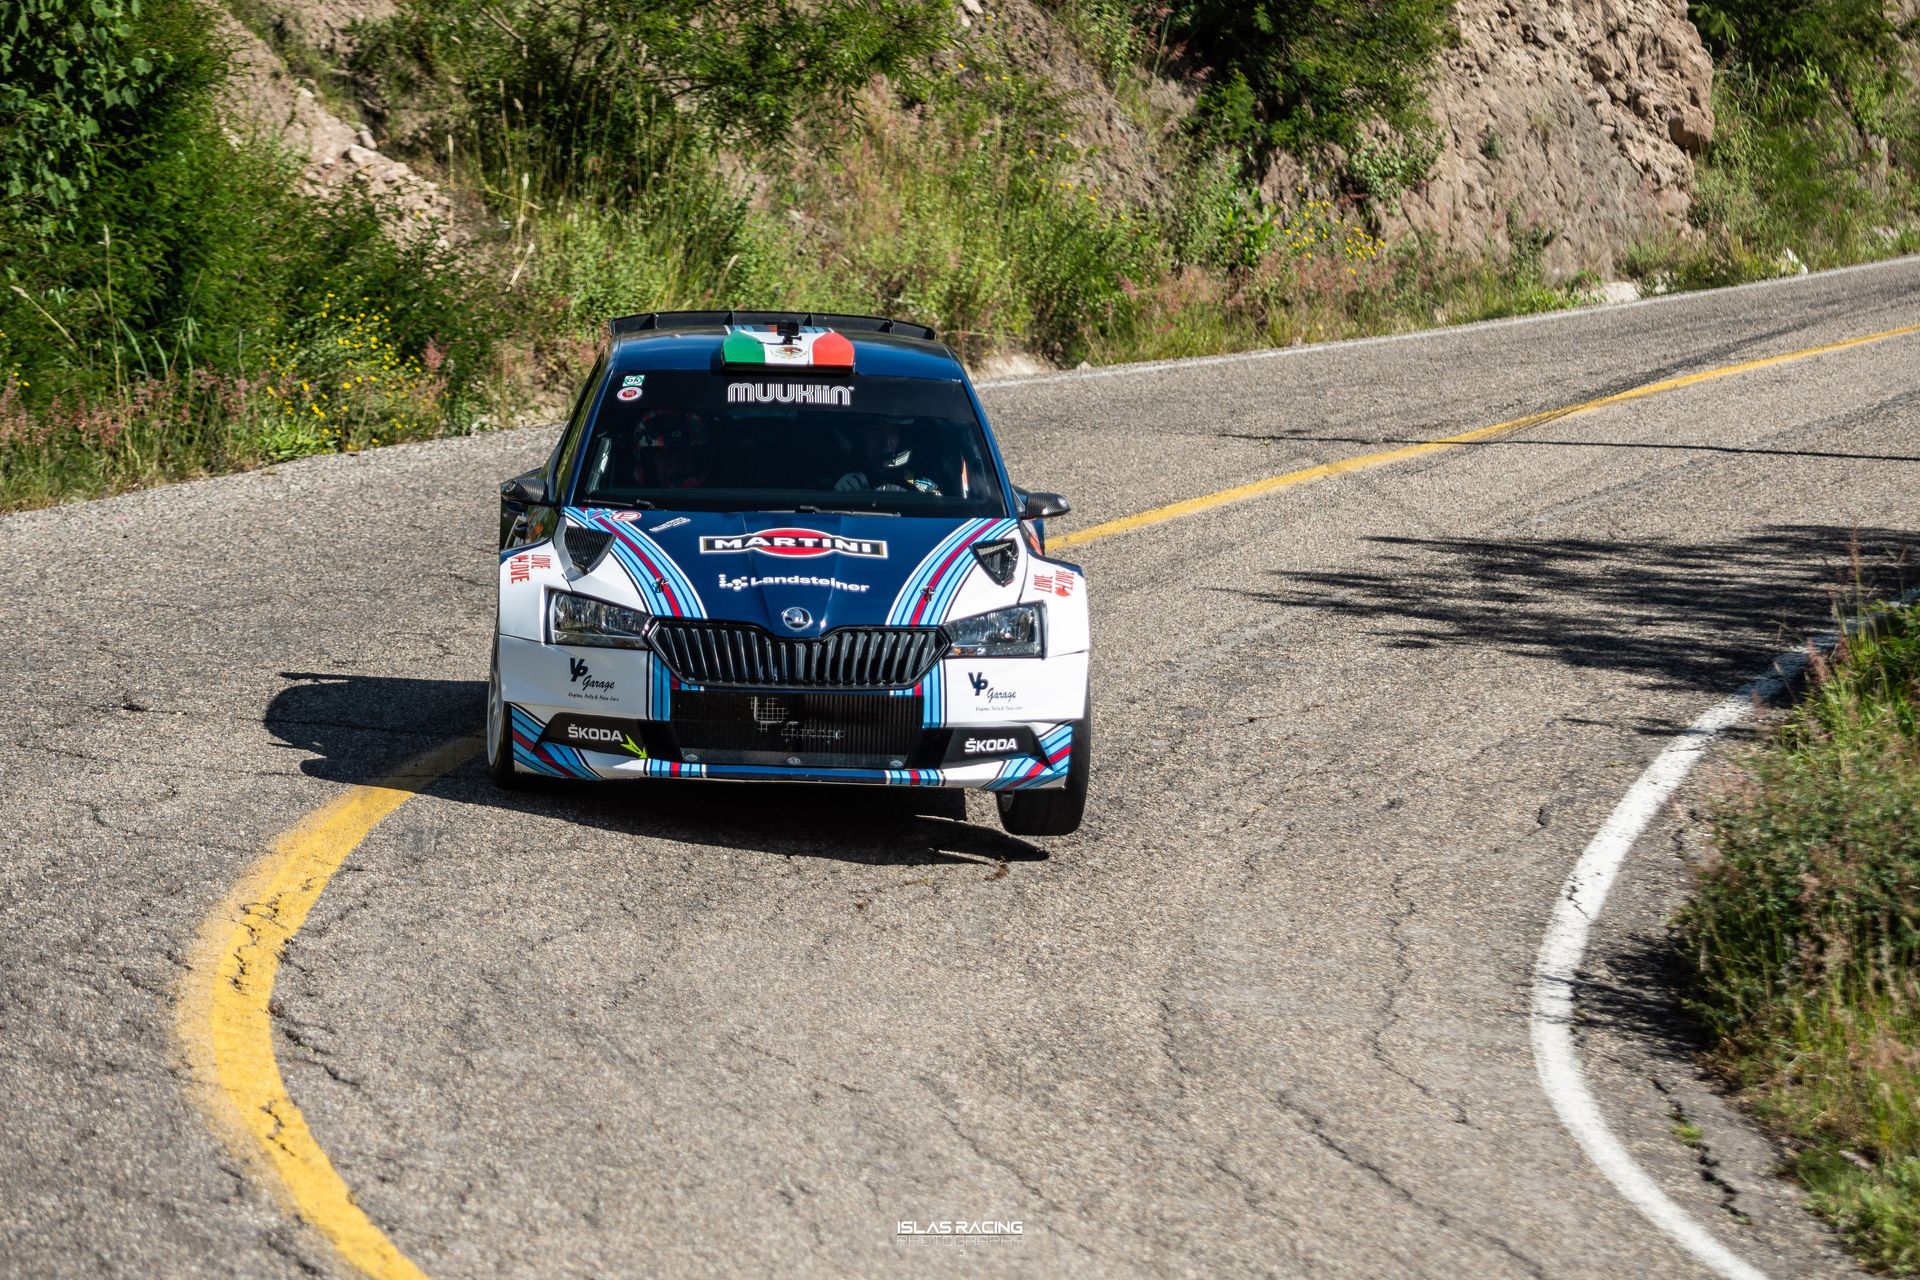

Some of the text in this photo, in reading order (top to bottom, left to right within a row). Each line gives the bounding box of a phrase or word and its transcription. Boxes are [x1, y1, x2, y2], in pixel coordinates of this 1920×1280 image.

[714, 536, 872, 553] MARTINI
[531, 554, 551, 569] LOVE
[510, 560, 530, 584] LOVE
[750, 575, 870, 592] Landsteiner
[1033, 574, 1053, 593] LOVE
[569, 657, 589, 682] VP
[582, 675, 616, 692] Garage
[968, 672, 989, 696] VP
[986, 687, 1017, 704] Garage
[567, 723, 624, 742] ŠKODA
[964, 737, 1018, 753] ŠKODA
